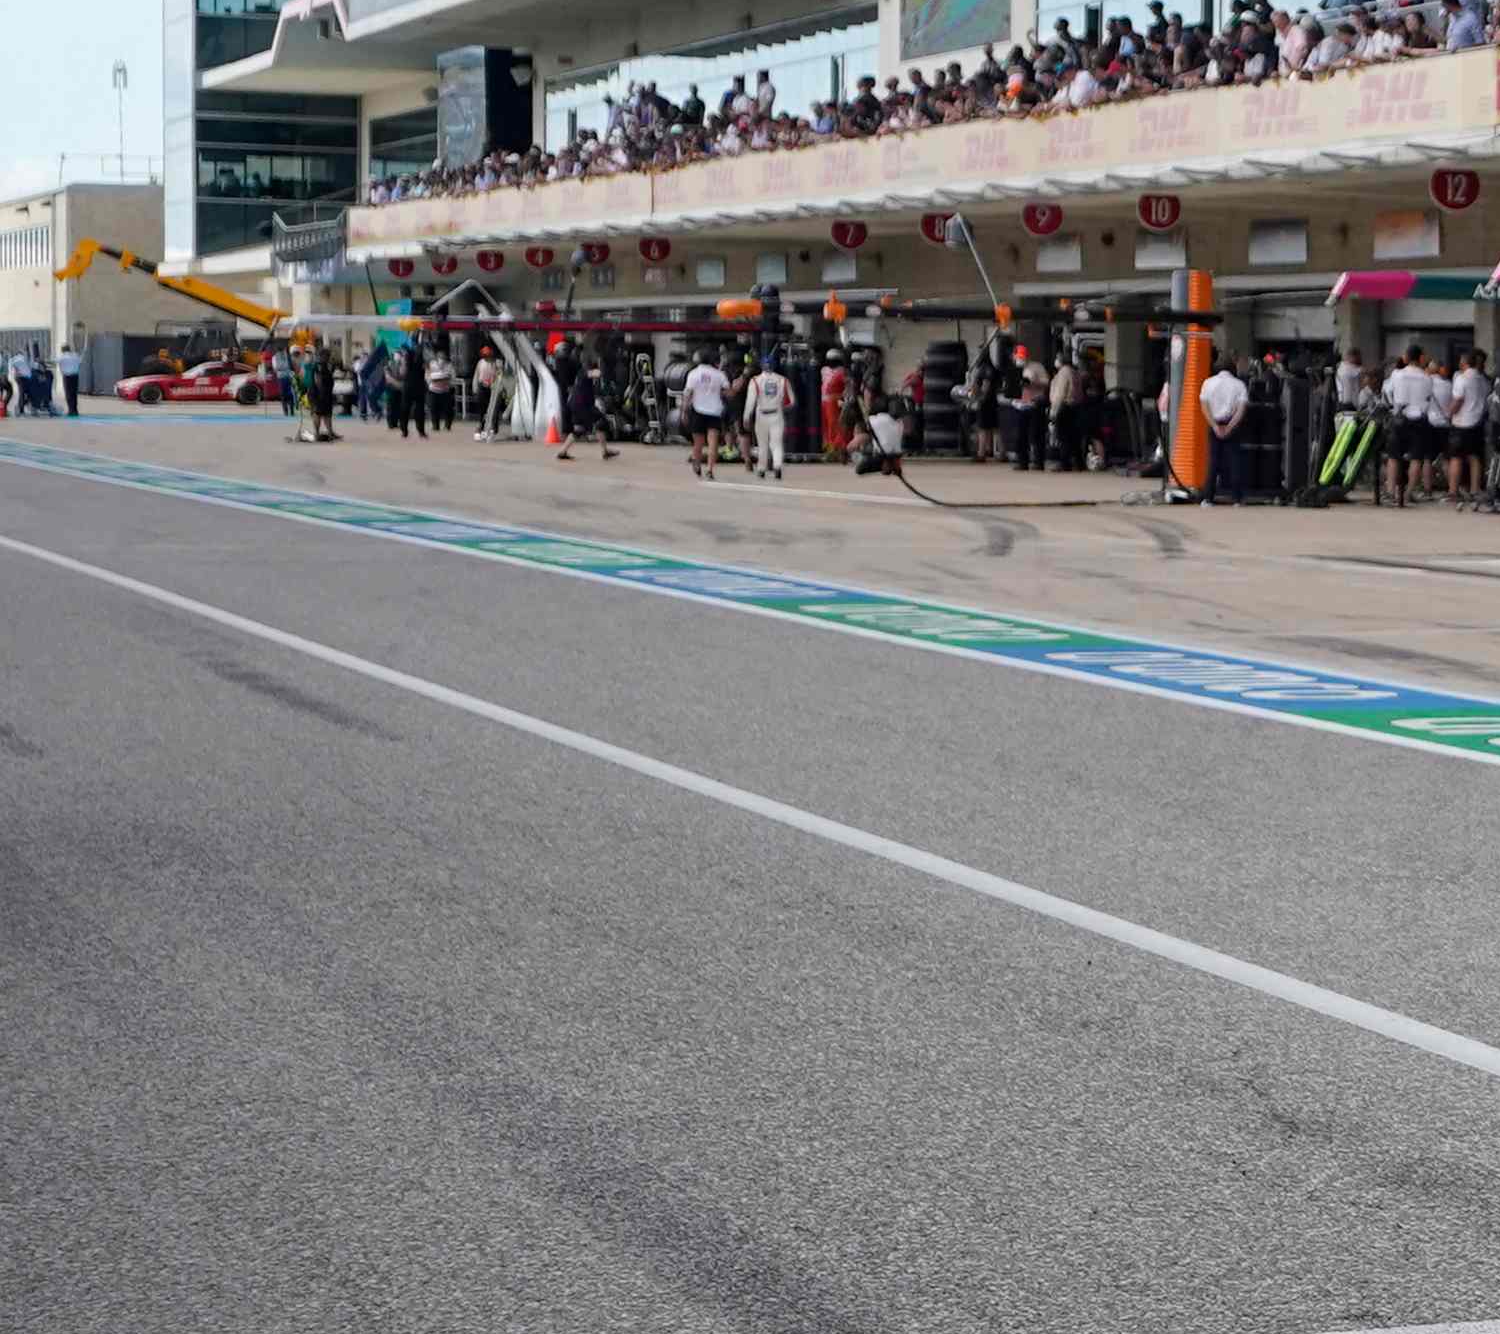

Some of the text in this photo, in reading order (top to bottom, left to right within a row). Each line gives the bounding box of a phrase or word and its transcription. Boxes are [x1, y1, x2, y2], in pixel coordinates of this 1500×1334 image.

[1357, 71, 1432, 123] DHL
[1446, 173, 1468, 203] 12
[1036, 207, 1048, 226] 9
[1152, 197, 1170, 222] 10
